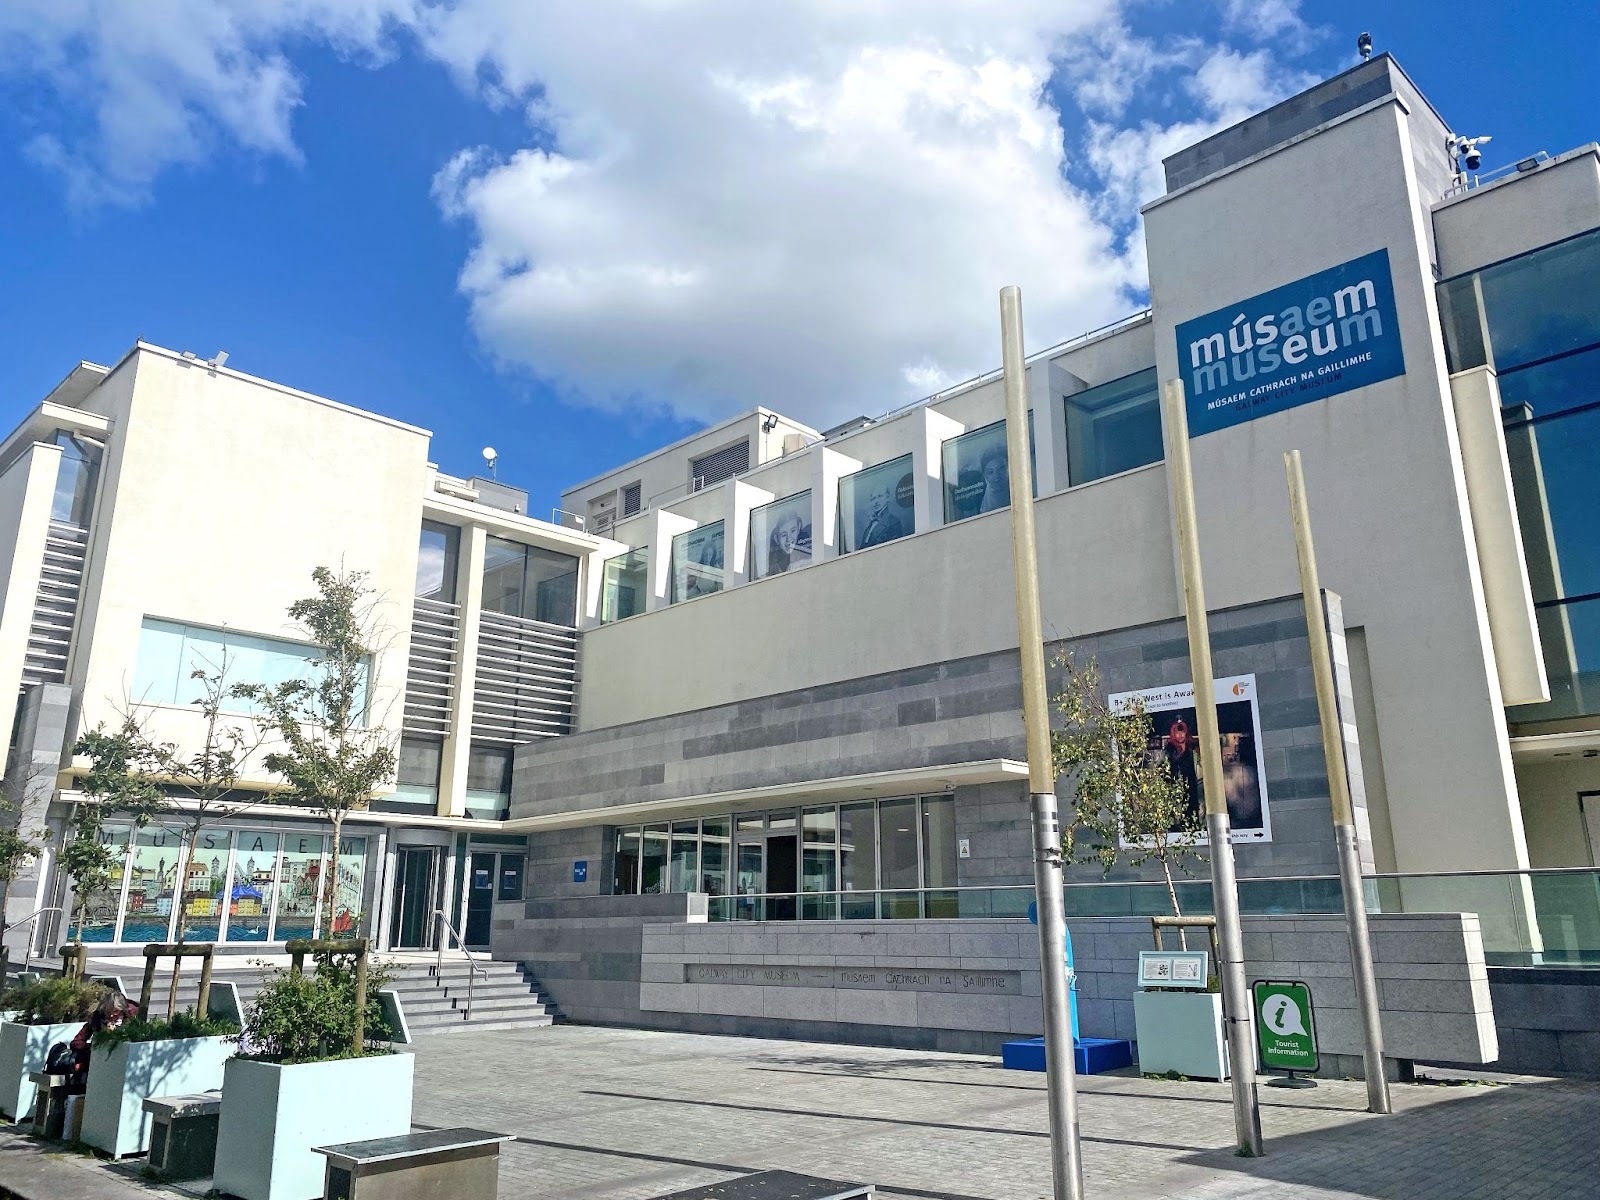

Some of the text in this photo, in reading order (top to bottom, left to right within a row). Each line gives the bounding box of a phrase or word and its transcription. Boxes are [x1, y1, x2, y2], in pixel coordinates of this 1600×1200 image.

[1190, 279, 1377, 368] músaem
[1193, 306, 1383, 395] museum
[1207, 351, 1372, 410] MÚSAEM CATHRACH NA GAILLIMHE
[1234, 371, 1343, 412] GALWAY CITY MUSEUM
[1165, 692, 1172, 700] is
[1174, 688, 1196, 699] Awak
[699, 968, 728, 979] GALWAY
[736, 968, 756, 979] CITY
[763, 970, 801, 981] MUSEUM
[1267, 1046, 1309, 1057] Information
[1275, 1039, 1300, 1048] Tourist
